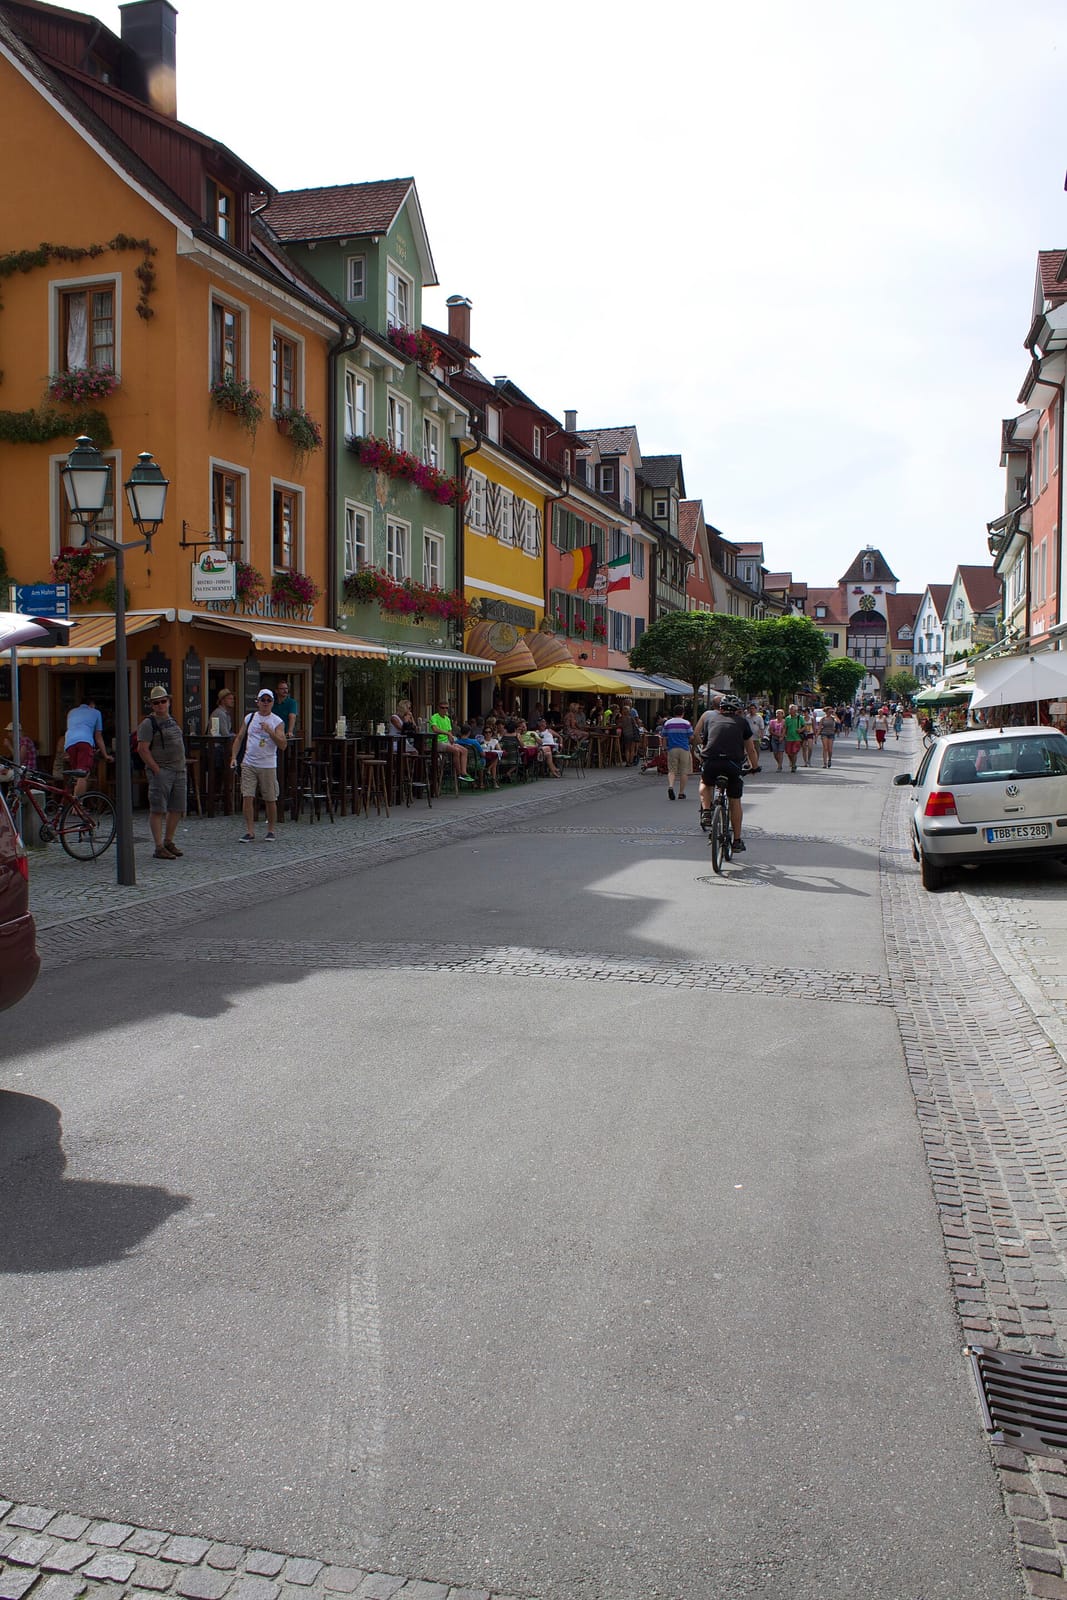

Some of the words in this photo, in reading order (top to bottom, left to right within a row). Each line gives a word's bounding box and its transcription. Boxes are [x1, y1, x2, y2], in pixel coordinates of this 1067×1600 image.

[144, 665, 169, 674] Bistro
[993, 828, 1011, 840] TBB
[1016, 827, 1029, 837] ES
[1030, 825, 1047, 836] 288
